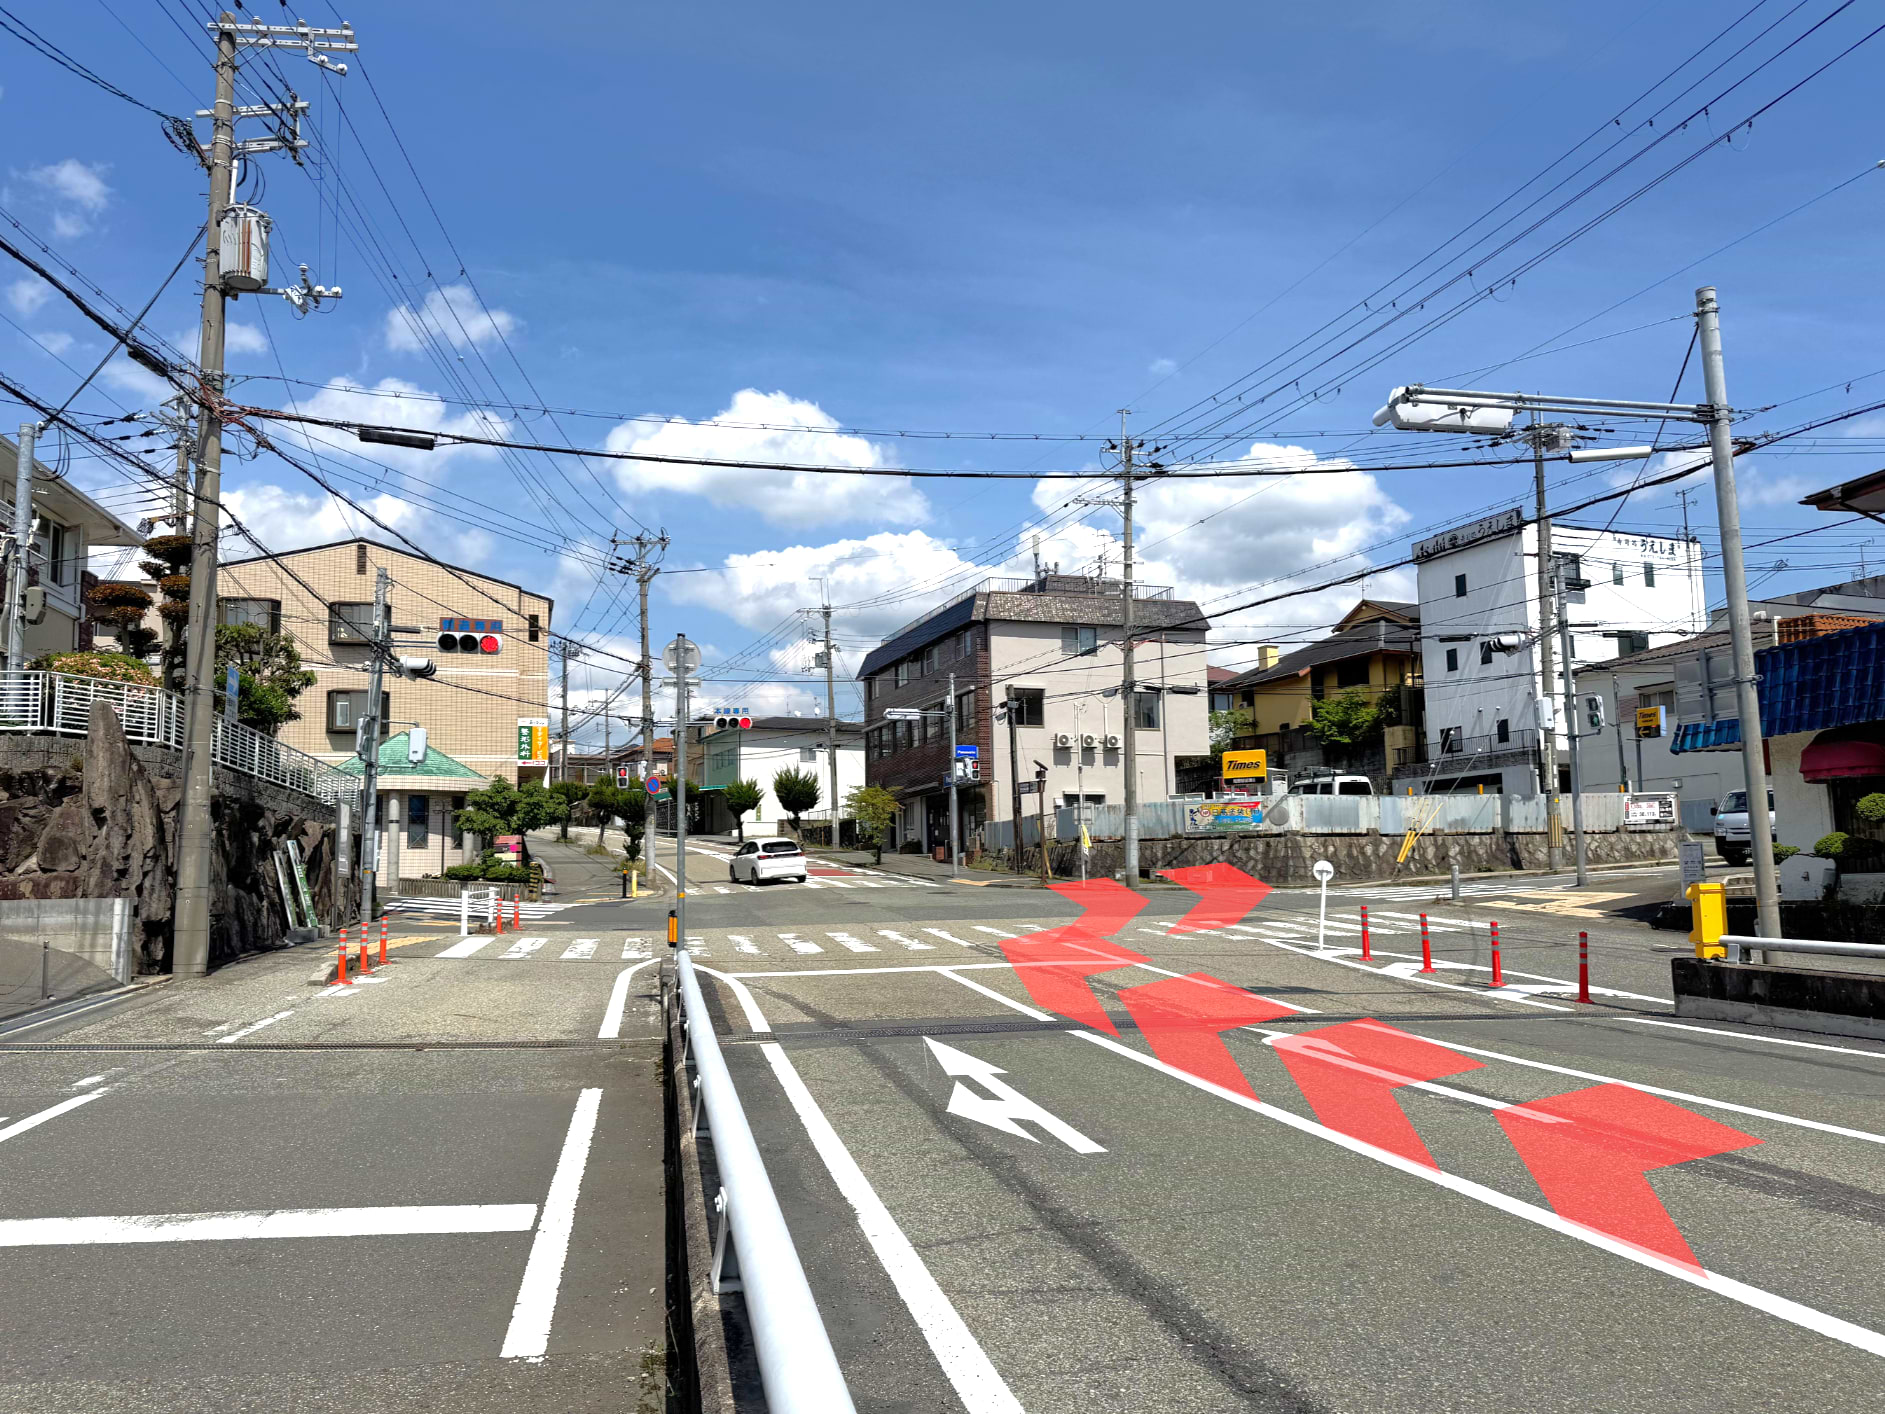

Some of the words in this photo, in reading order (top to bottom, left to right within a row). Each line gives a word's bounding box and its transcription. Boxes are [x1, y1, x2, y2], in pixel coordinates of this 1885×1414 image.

[1640, 538, 1677, 557] うえしま
[520, 727, 531, 758] 整形外科
[1226, 760, 1261, 770] Times
